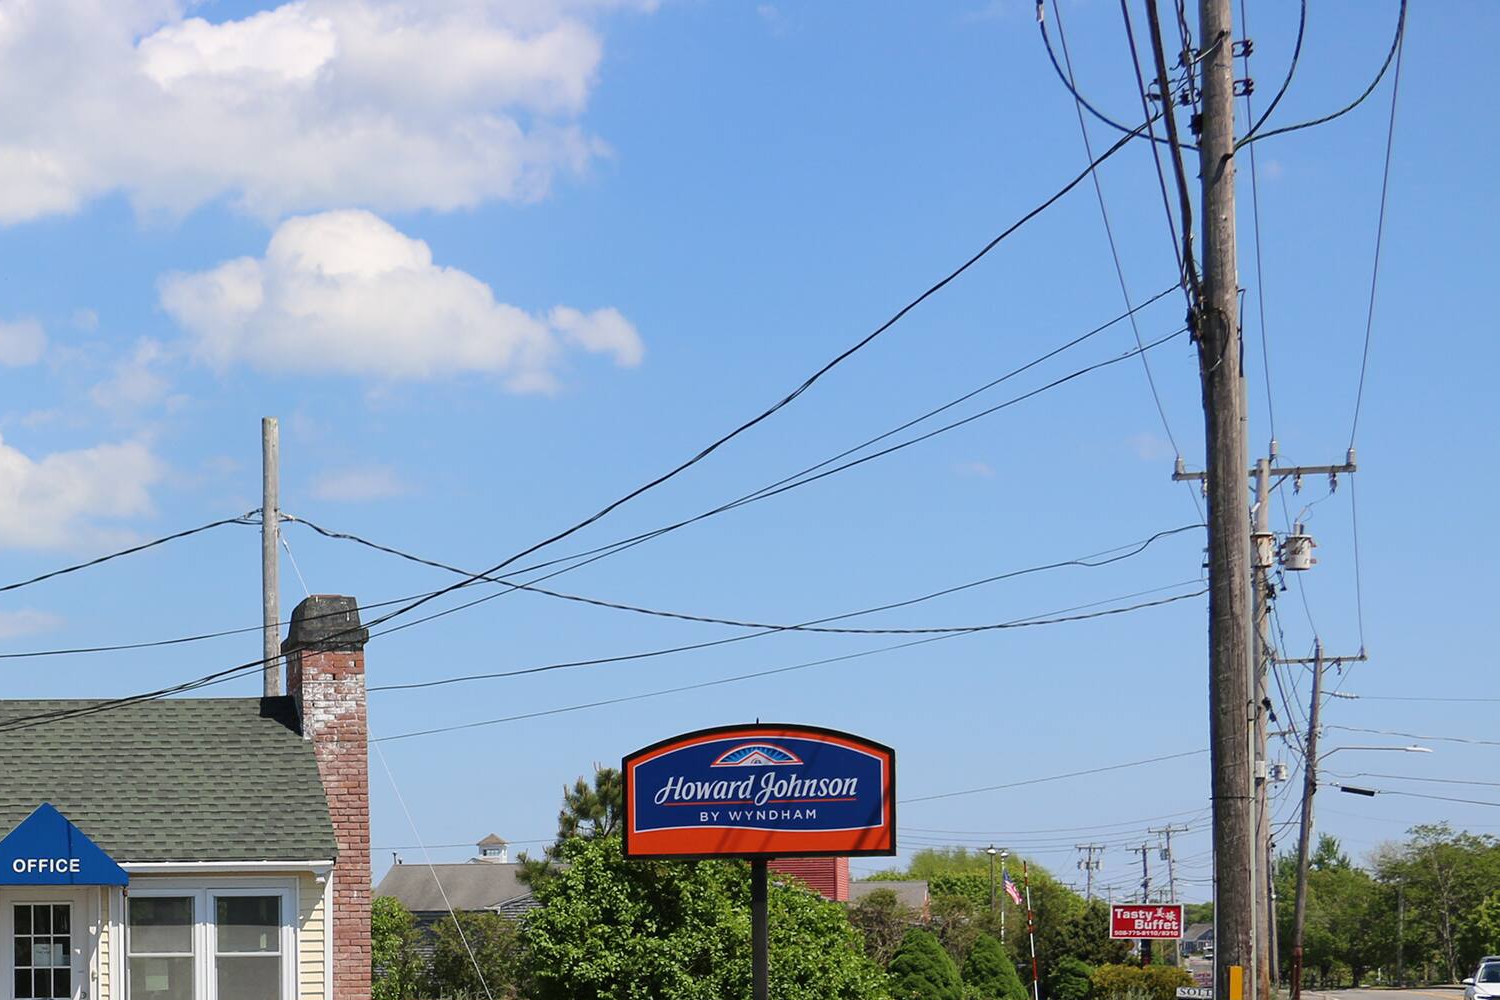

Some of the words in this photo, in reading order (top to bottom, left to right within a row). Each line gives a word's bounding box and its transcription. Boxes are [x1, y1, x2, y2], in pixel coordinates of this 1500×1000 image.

[654, 774, 754, 805] Howard
[754, 771, 858, 806] Johnson
[700, 811, 719, 822] BY
[728, 808, 817, 821] WYNDHAM
[12, 858, 81, 873] OFFICE
[1114, 908, 1153, 921] Tasty
[1134, 919, 1179, 930] Buffet
